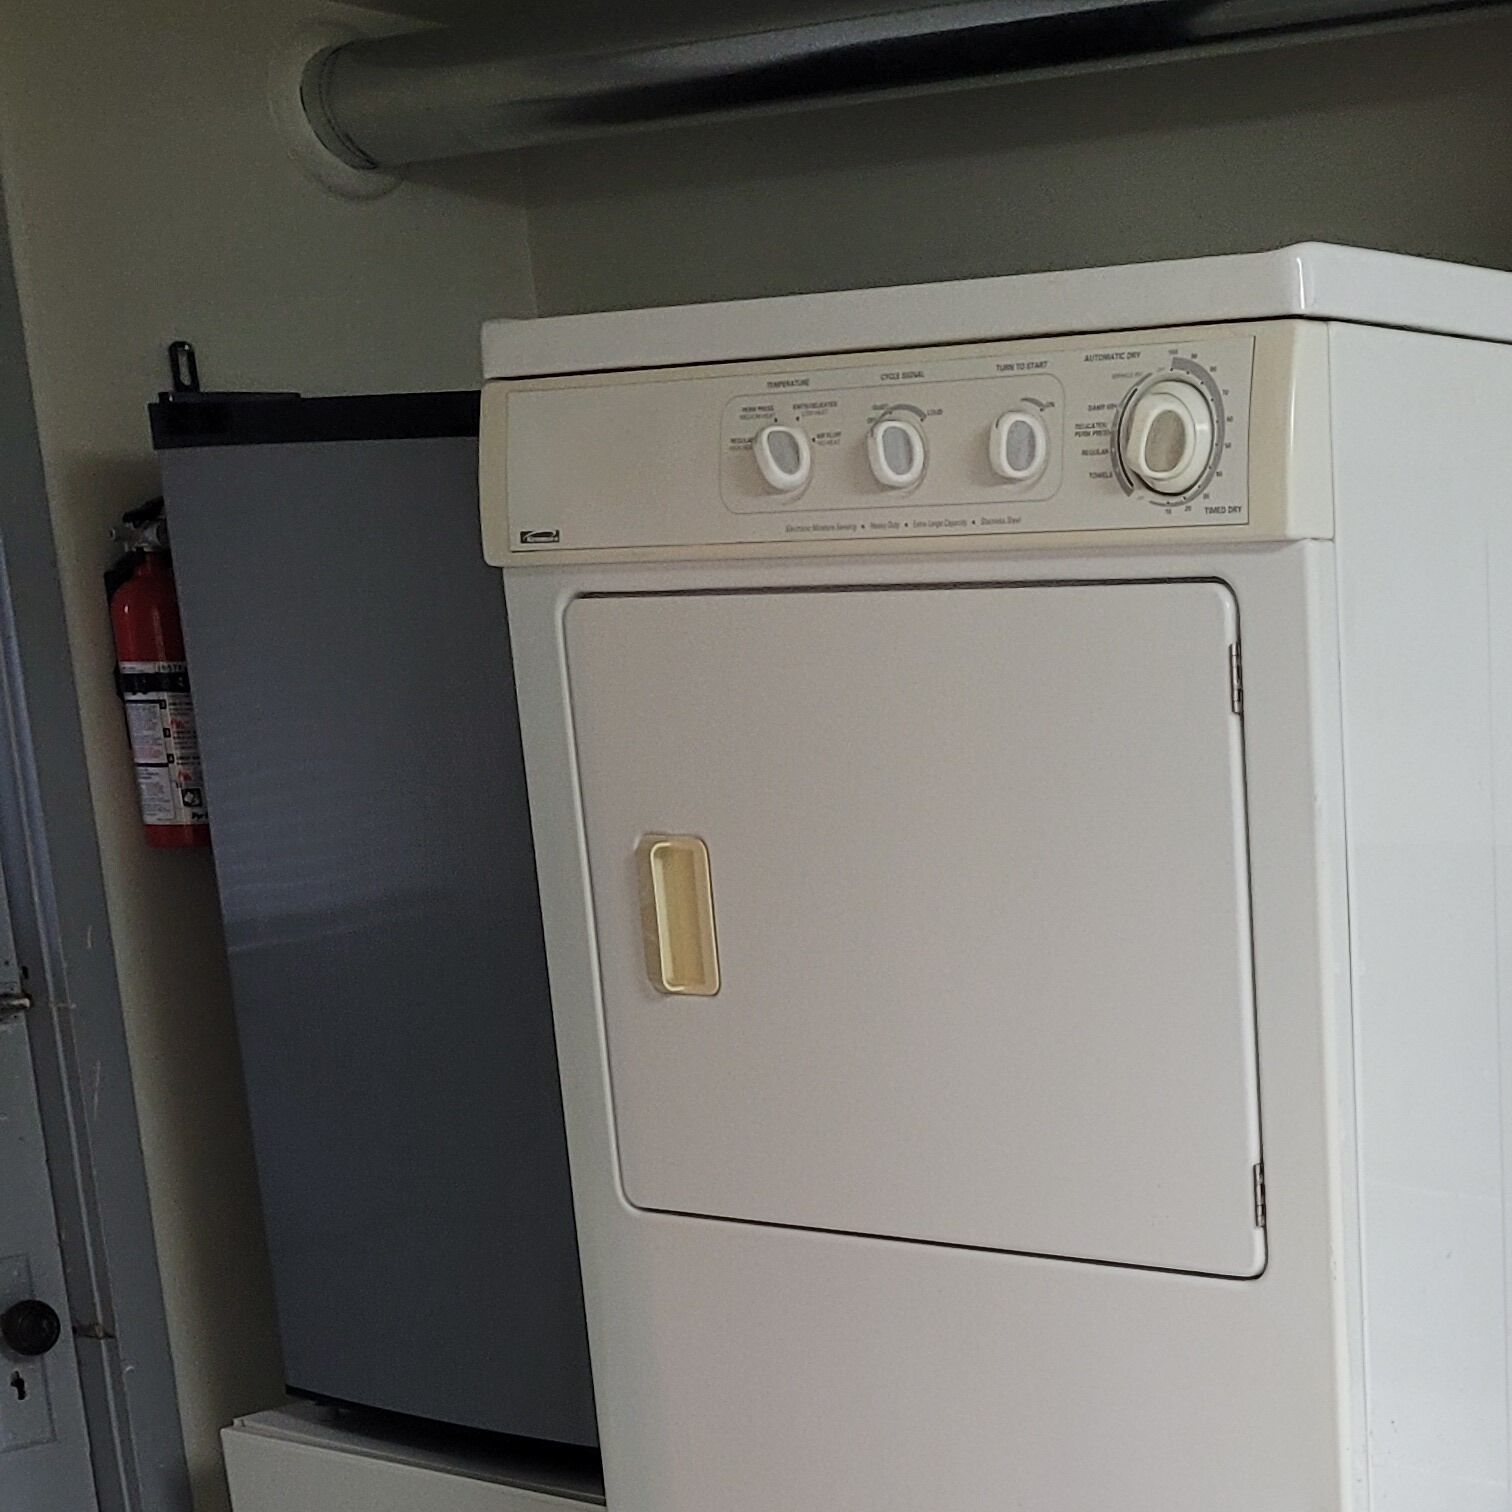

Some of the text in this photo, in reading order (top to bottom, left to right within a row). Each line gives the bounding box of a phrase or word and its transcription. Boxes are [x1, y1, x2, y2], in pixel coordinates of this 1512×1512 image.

[1084, 351, 1141, 362] AUTOMATIC DRY
[996, 361, 1048, 371] TURN TO START
[1205, 505, 1242, 514] TIMED DRY
